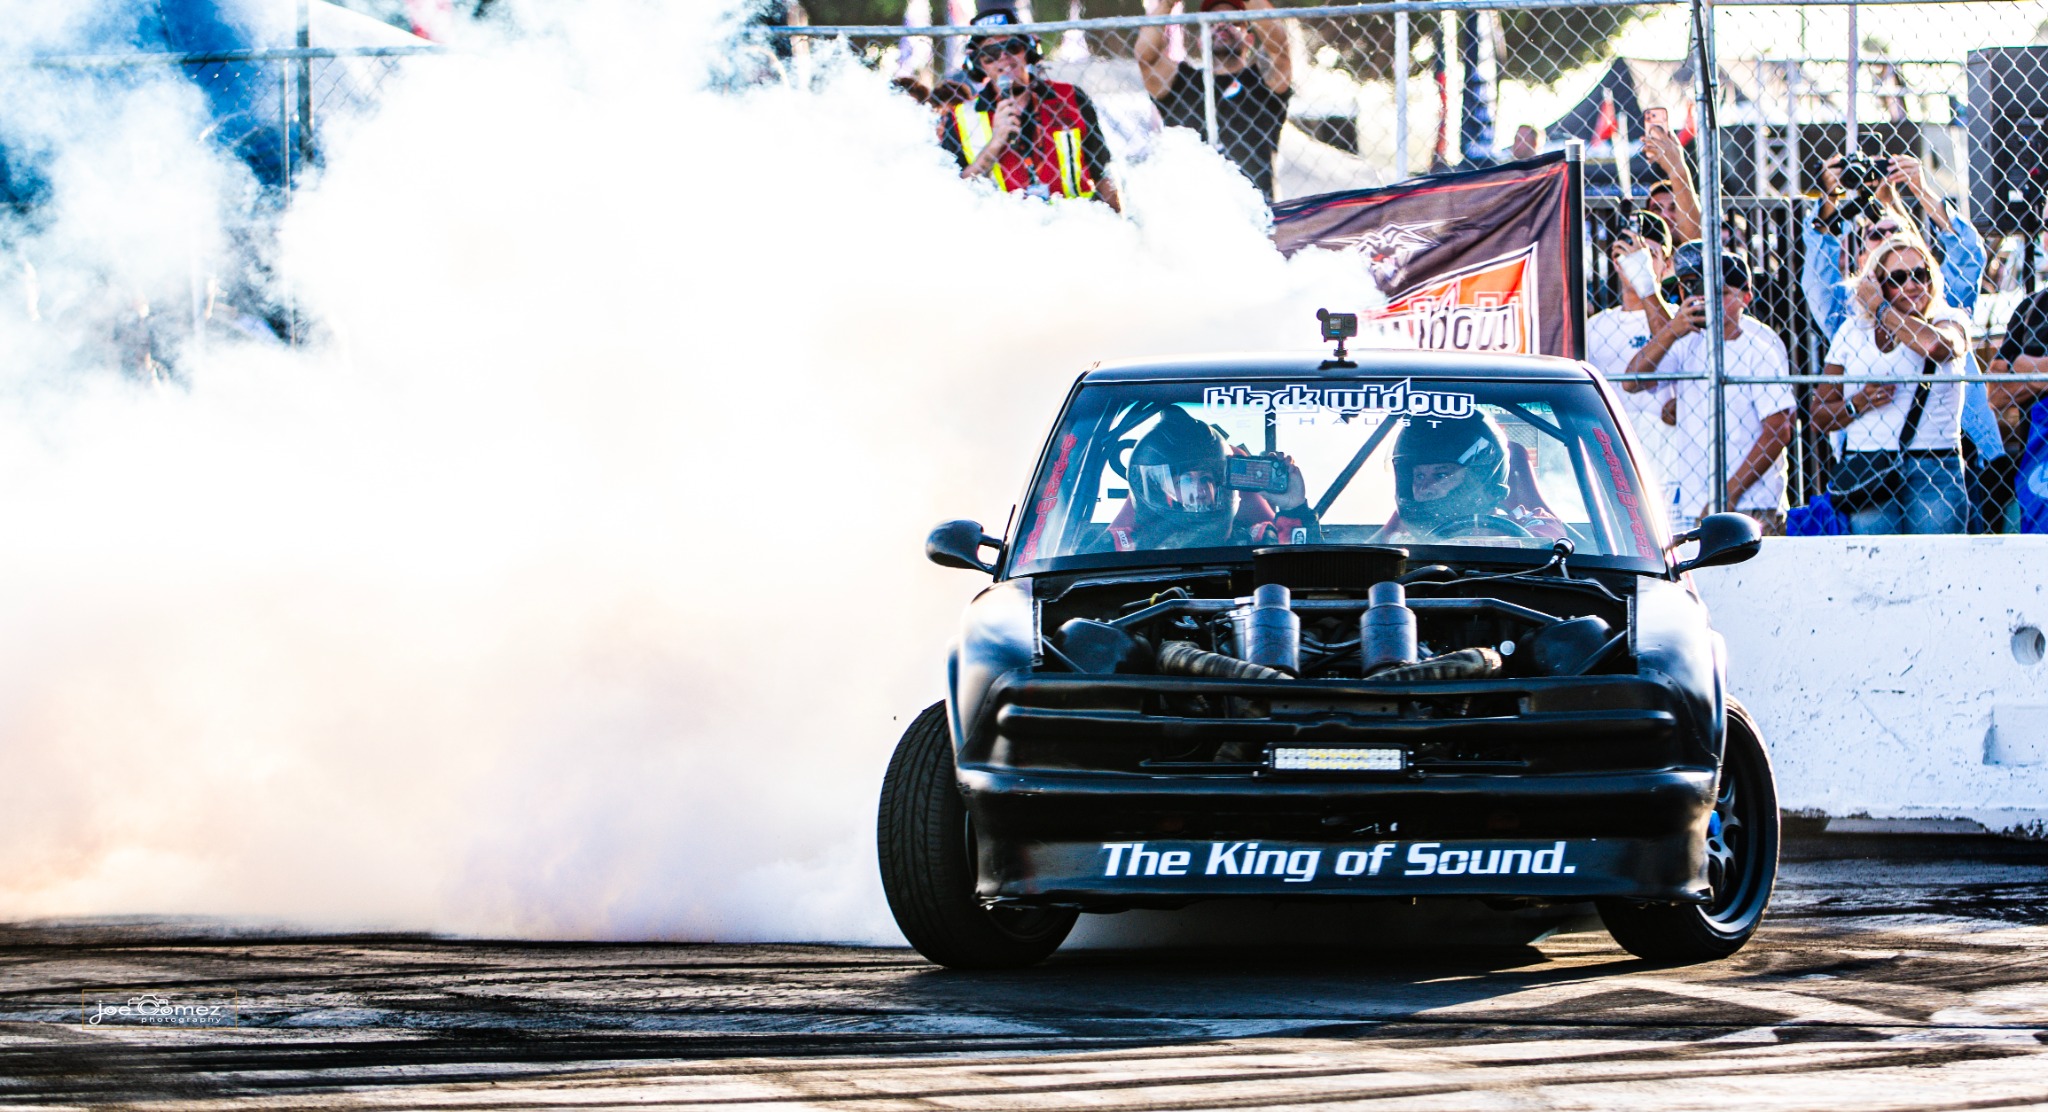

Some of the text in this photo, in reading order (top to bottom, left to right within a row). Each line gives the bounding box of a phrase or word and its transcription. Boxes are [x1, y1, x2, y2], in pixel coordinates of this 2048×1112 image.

[1203, 377, 1476, 418] black widow
[1236, 418, 1443, 429] EXHAUST
[1102, 841, 1576, 882] The King of Sound.
